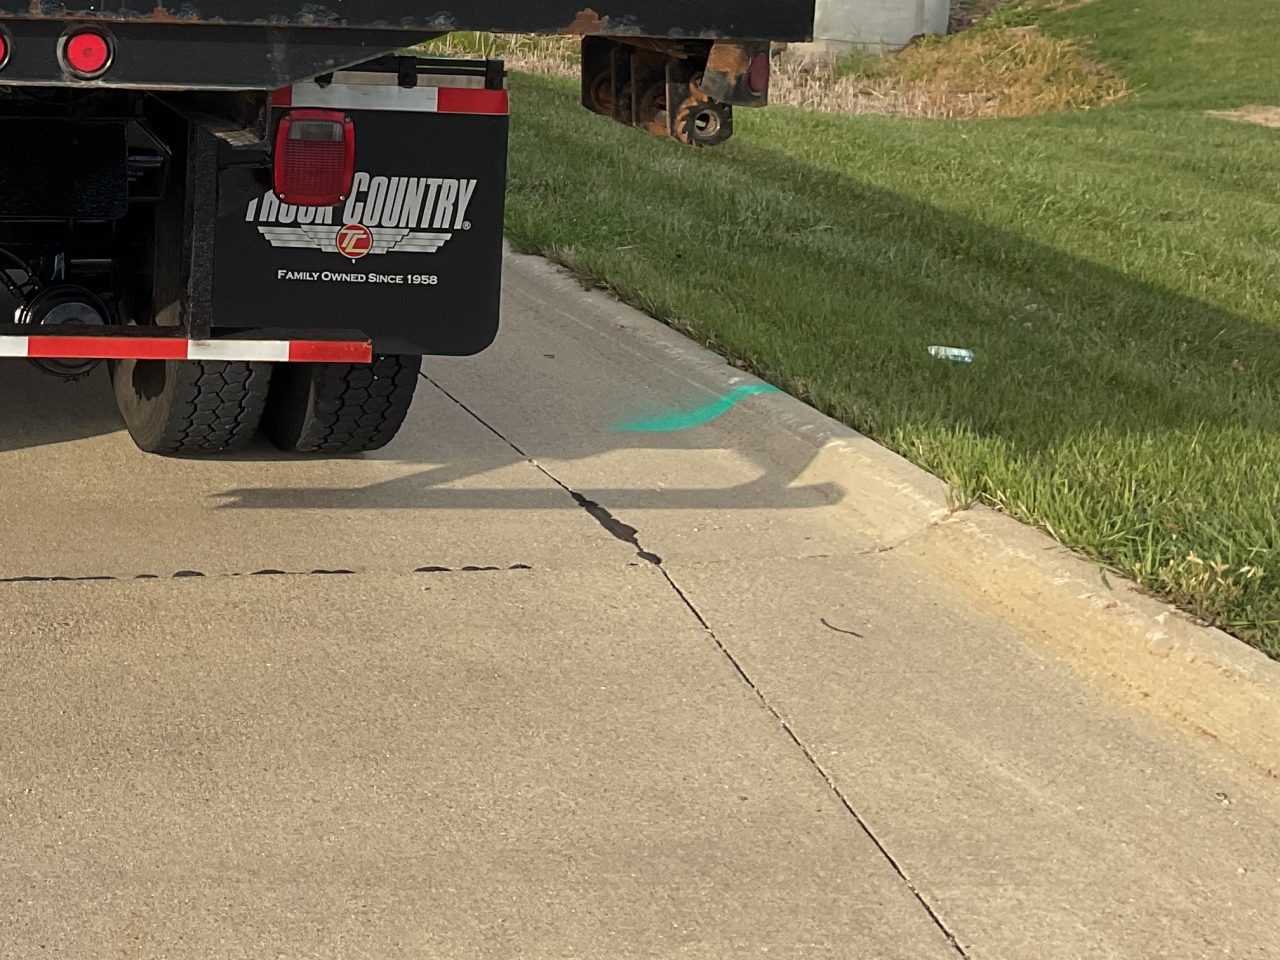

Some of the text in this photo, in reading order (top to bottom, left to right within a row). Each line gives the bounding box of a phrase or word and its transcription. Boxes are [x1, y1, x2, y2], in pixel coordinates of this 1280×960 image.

[342, 172, 477, 230] COUNTRY
[277, 269, 438, 285] FAMILY OWNED SINCE 1958
